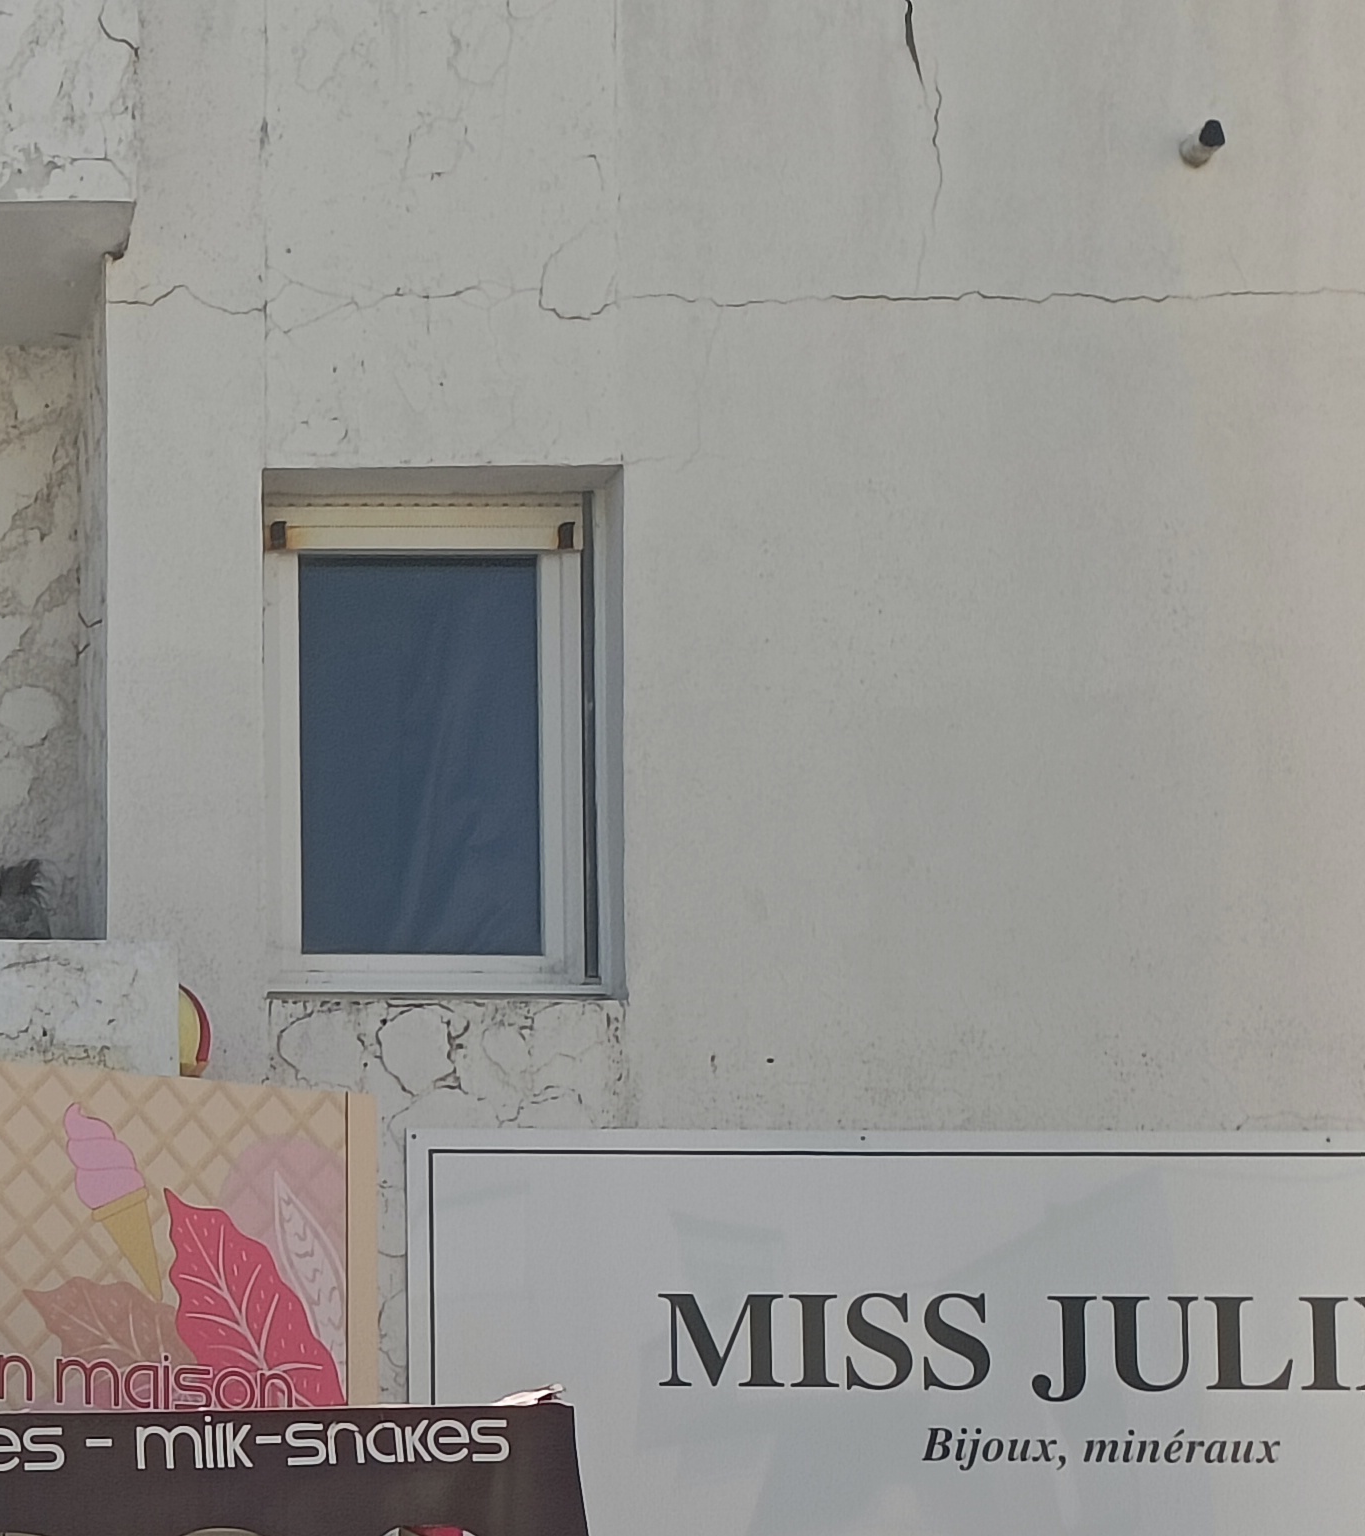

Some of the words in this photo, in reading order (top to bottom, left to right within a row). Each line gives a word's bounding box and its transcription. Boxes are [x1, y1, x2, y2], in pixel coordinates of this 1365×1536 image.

[657, 1292, 992, 1392] MISS
[1031, 1294, 1365, 1403] JULI
[55, 1354, 295, 1410] maison
[922, 1426, 1068, 1471] Bijoux,
[1082, 1427, 1282, 1465] minéraux
